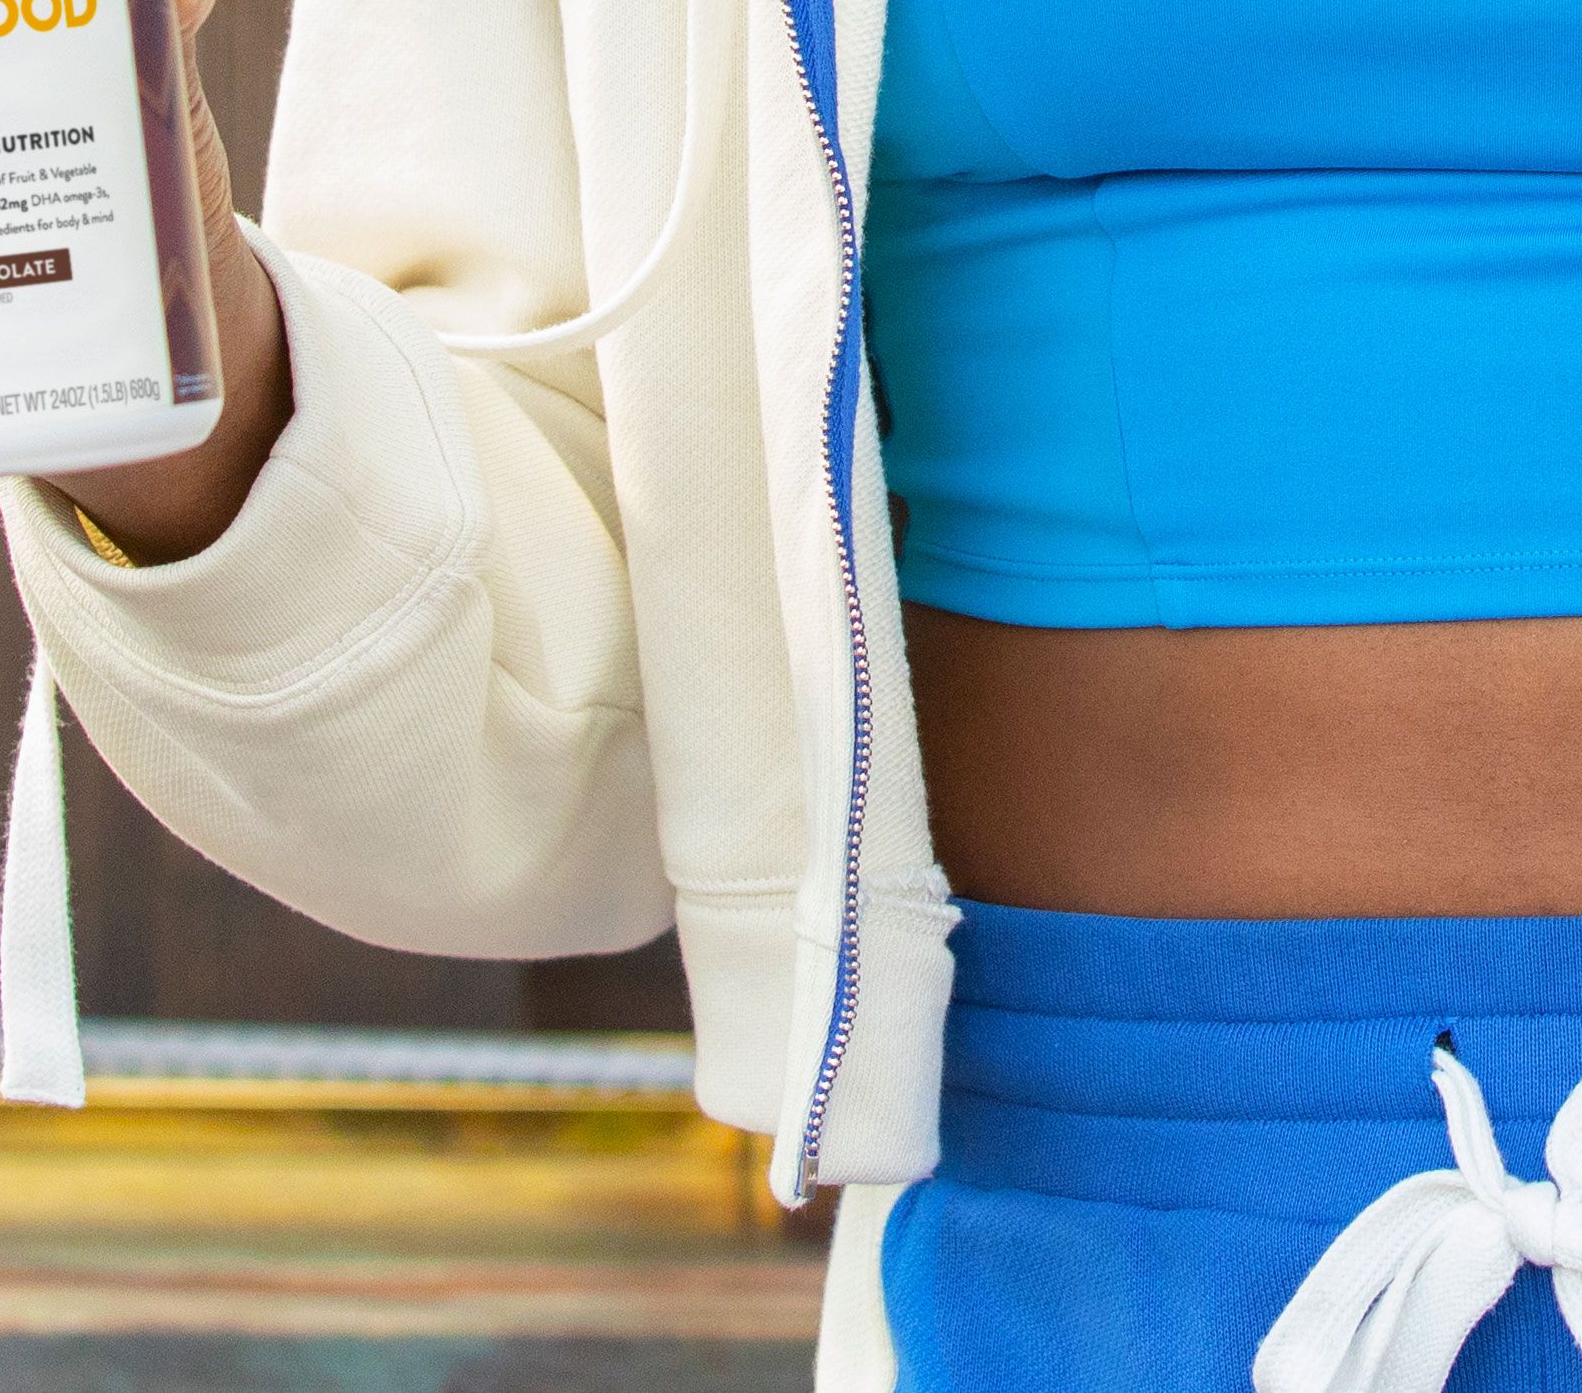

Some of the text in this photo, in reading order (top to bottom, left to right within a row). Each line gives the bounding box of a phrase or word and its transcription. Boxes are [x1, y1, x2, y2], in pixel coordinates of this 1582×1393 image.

[9, 171, 36, 184] Fruit
[39, 168, 48, 181] &
[50, 163, 97, 182] Vegetable
[31, 192, 61, 207] DHA
[63, 186, 110, 204] omega-3s,
[37, 219, 53, 231] for
[56, 216, 80, 230] body
[82, 213, 90, 225] &
[91, 210, 114, 224] mind
[23, 390, 47, 412] WT
[88, 381, 128, 410] (1.5LB)
[130, 377, 161, 402] 680g
